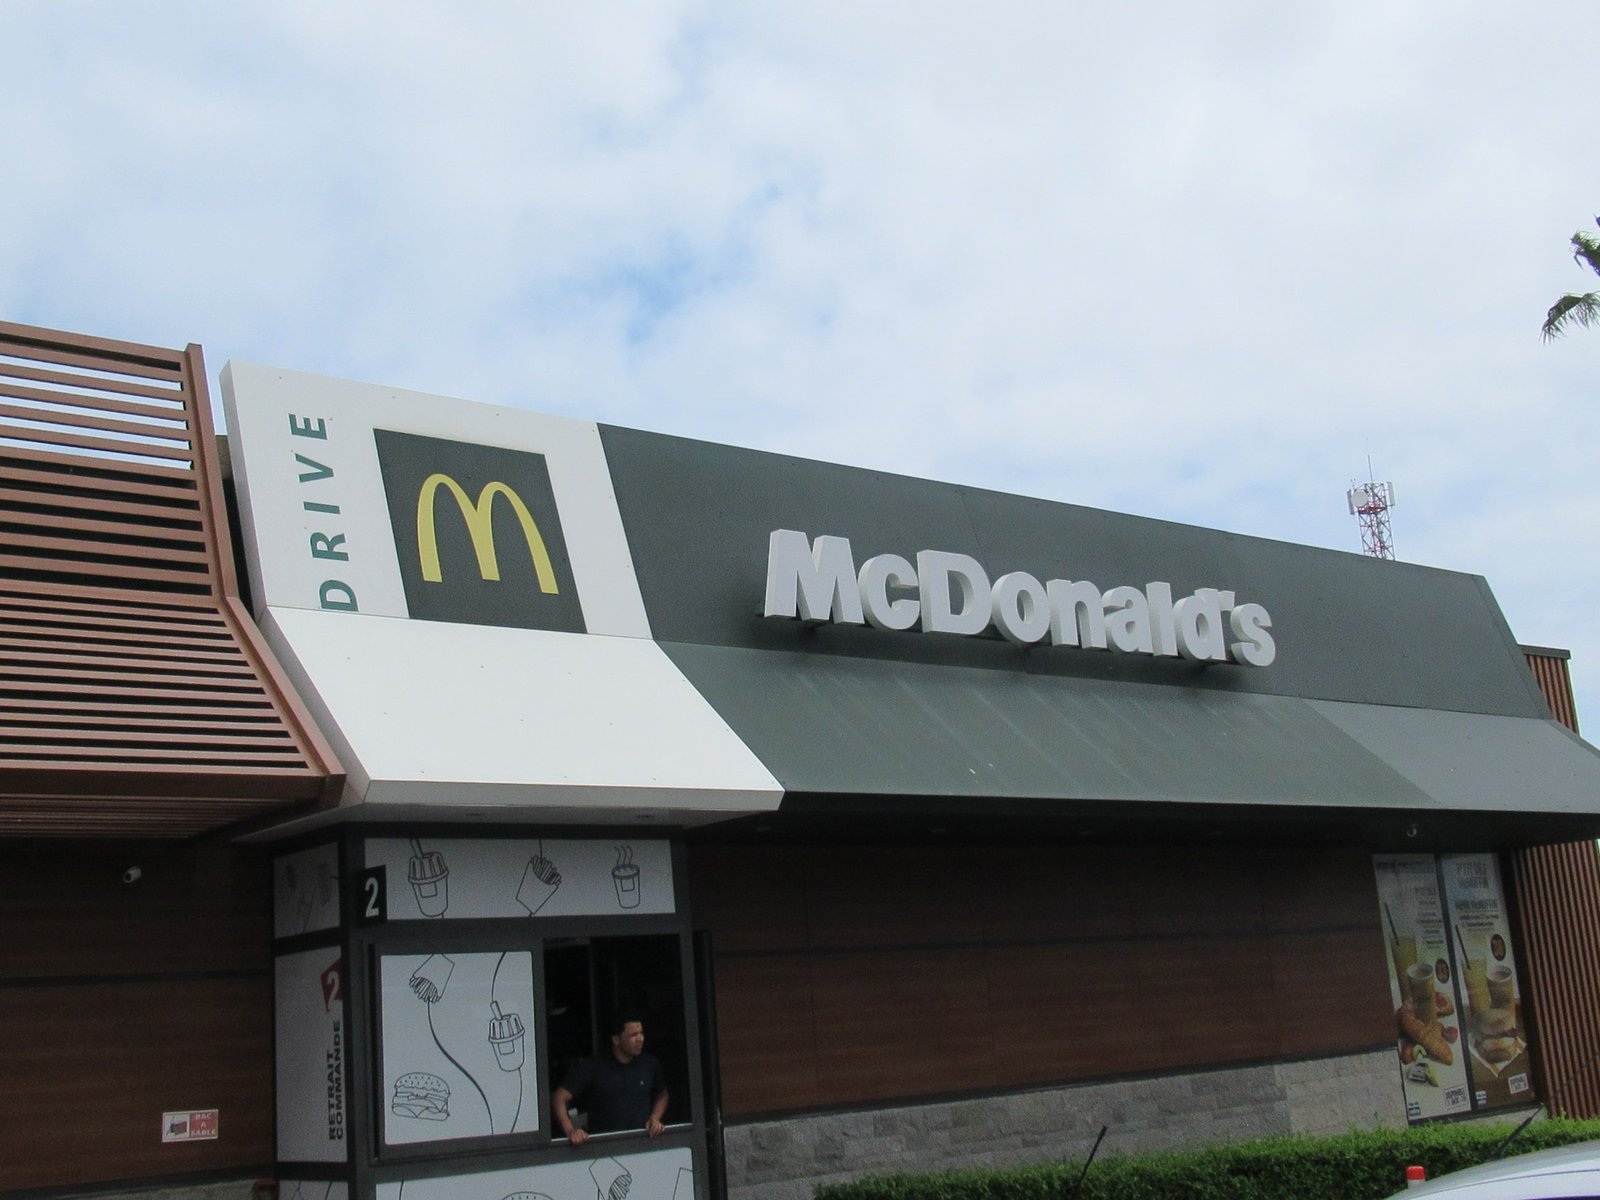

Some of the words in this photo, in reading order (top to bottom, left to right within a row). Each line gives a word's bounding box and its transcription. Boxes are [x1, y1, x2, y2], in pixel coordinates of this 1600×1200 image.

[289, 412, 360, 613] DRIVE
[763, 528, 1277, 668] McDonald's
[364, 876, 380, 919] 2
[326, 970, 341, 1010] 2
[326, 1049, 337, 1142] RETRAIT
[333, 1020, 344, 1141] COMMANDE
[190, 1128, 217, 1137] SABLE
[195, 1112, 213, 1121] BAC
